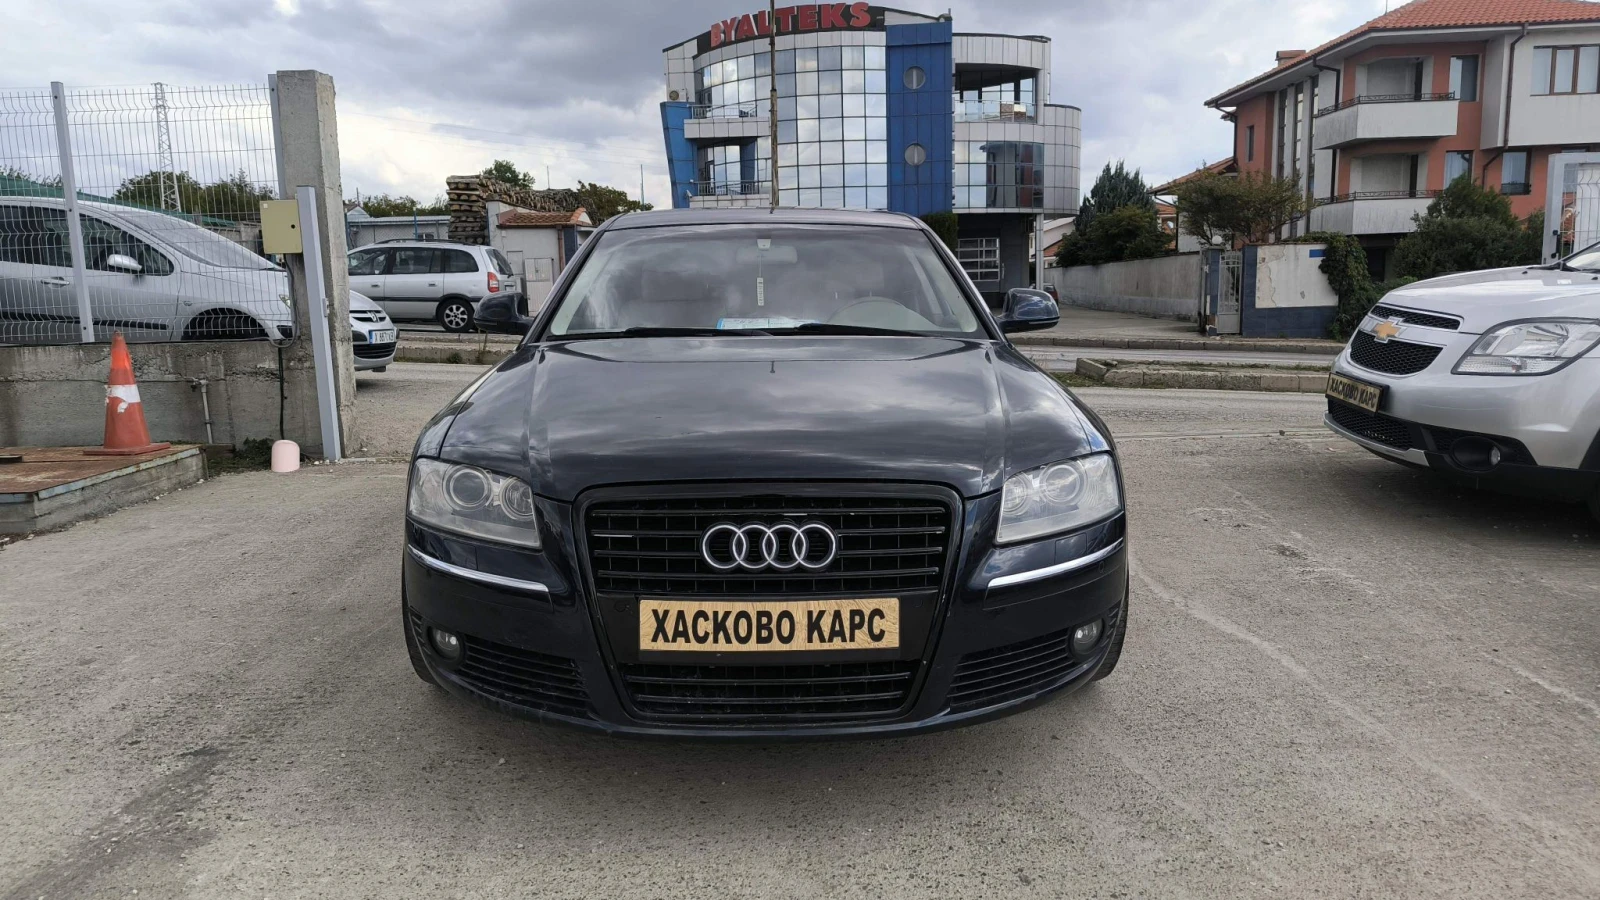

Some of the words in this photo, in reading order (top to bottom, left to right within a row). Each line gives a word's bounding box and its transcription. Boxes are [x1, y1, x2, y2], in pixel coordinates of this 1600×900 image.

[711, 2, 871, 48] BYALTEKS
[1330, 377, 1358, 401] ХАСКОВО
[1359, 387, 1377, 409] КАРС
[651, 608, 796, 645] ХАСКОВО
[806, 608, 886, 644] КАРС
